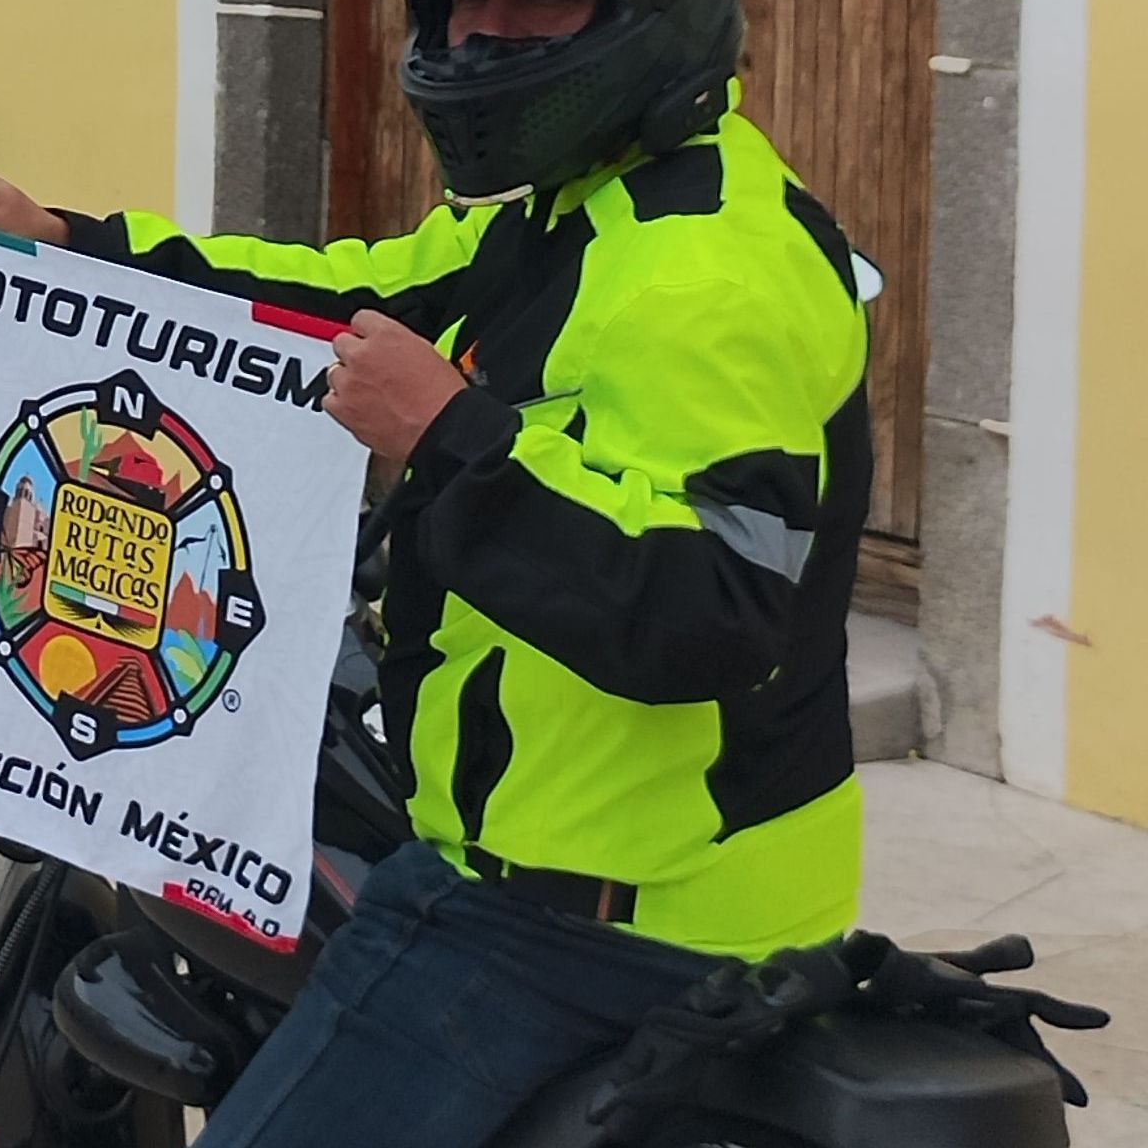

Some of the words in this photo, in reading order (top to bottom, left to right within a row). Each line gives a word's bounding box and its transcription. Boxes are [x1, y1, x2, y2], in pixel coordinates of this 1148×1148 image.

[111, 385, 146, 420] N
[225, 595, 252, 627] E
[69, 713, 99, 745] S
[119, 799, 292, 906] MÉXICO
